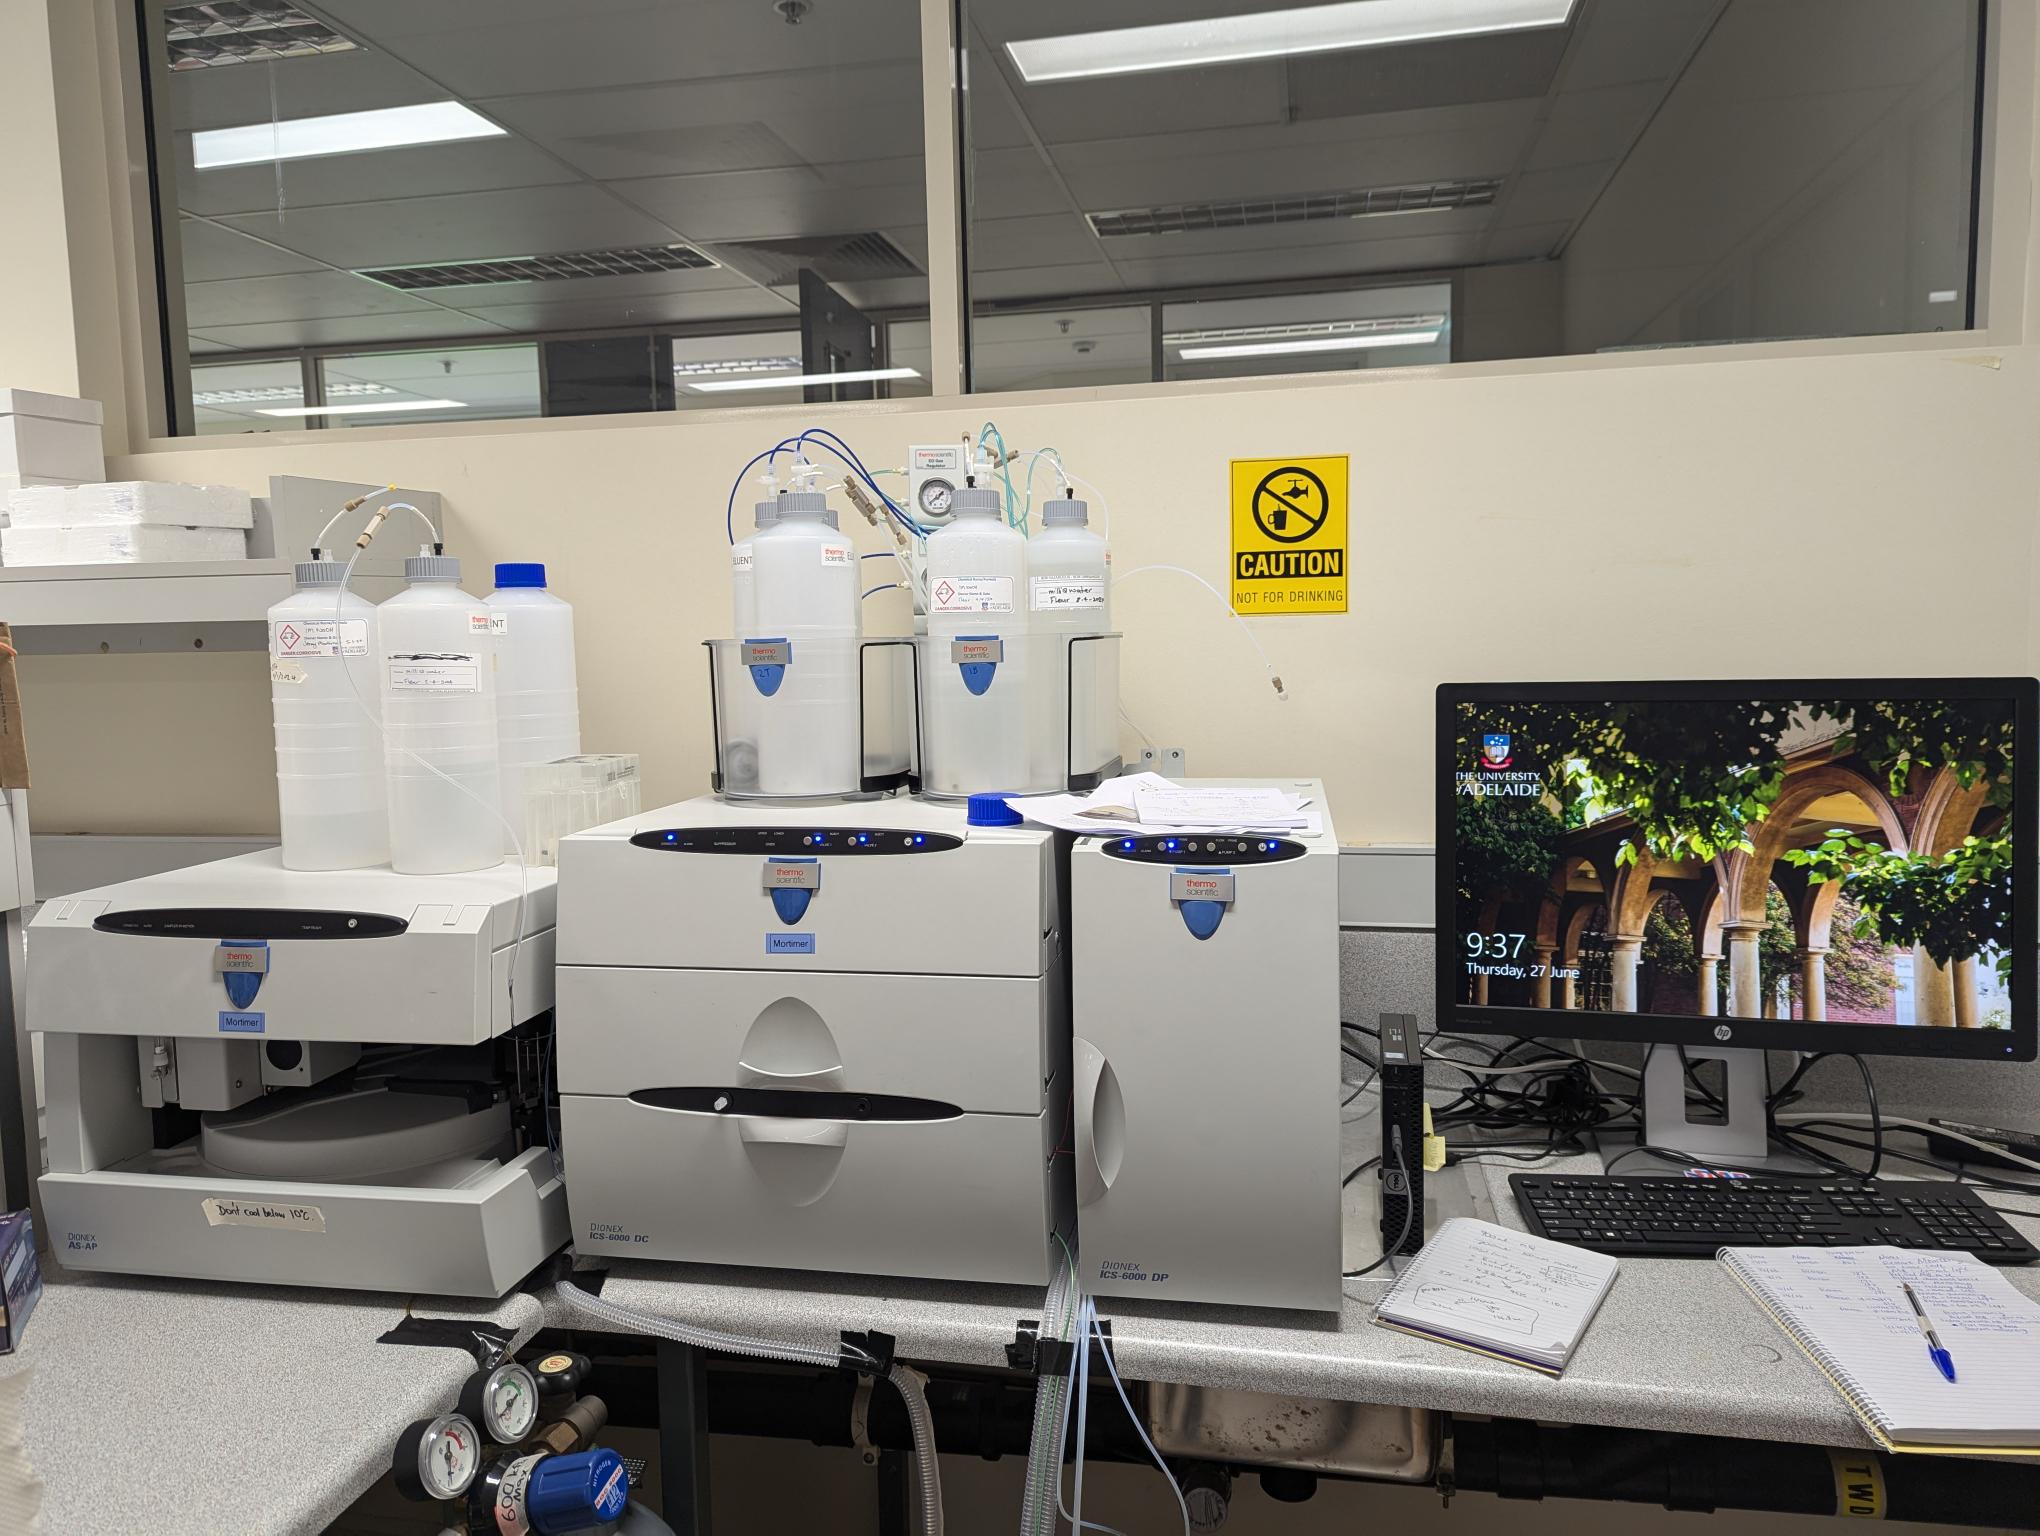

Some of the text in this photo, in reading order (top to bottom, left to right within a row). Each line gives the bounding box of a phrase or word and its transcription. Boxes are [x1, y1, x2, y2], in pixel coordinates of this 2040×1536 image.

[1240, 552, 1339, 577] CAUTION
[1236, 590, 1343, 603] NOT FOR DRINKING
[490, 619, 505, 628] NT
[964, 645, 988, 653] thermo
[1477, 772, 1540, 781] UNIVERSITY
[1463, 783, 1541, 796] ADELAIDE
[775, 868, 804, 876] thermo
[775, 876, 806, 884] scientific
[1186, 879, 1217, 888] thermo
[1186, 888, 1219, 897] scientific
[773, 939, 809, 948] Mortimer
[1466, 932, 1526, 959] 9:37
[226, 952, 253, 960] thermo
[1466, 962, 1580, 979] Thursday, 27 June
[225, 1017, 259, 1028] Mortimer
[1716, 1025, 1731, 1040] hp
[216, 1202, 240, 1216] Don't
[243, 1207, 260, 1217] cool
[262, 1207, 286, 1218] below
[590, 1223, 624, 1233] DIONEX
[68, 1233, 96, 1241] DIONEX
[590, 1231, 649, 1243] ICS-6000 DC
[68, 1241, 98, 1251] AS-AP
[1102, 1261, 1141, 1271] DIONEX
[1100, 1270, 1169, 1282] ICS-6000 DP
[593, 1460, 611, 1487] NITROGEN
[1846, 1465, 1875, 1515] TWD
